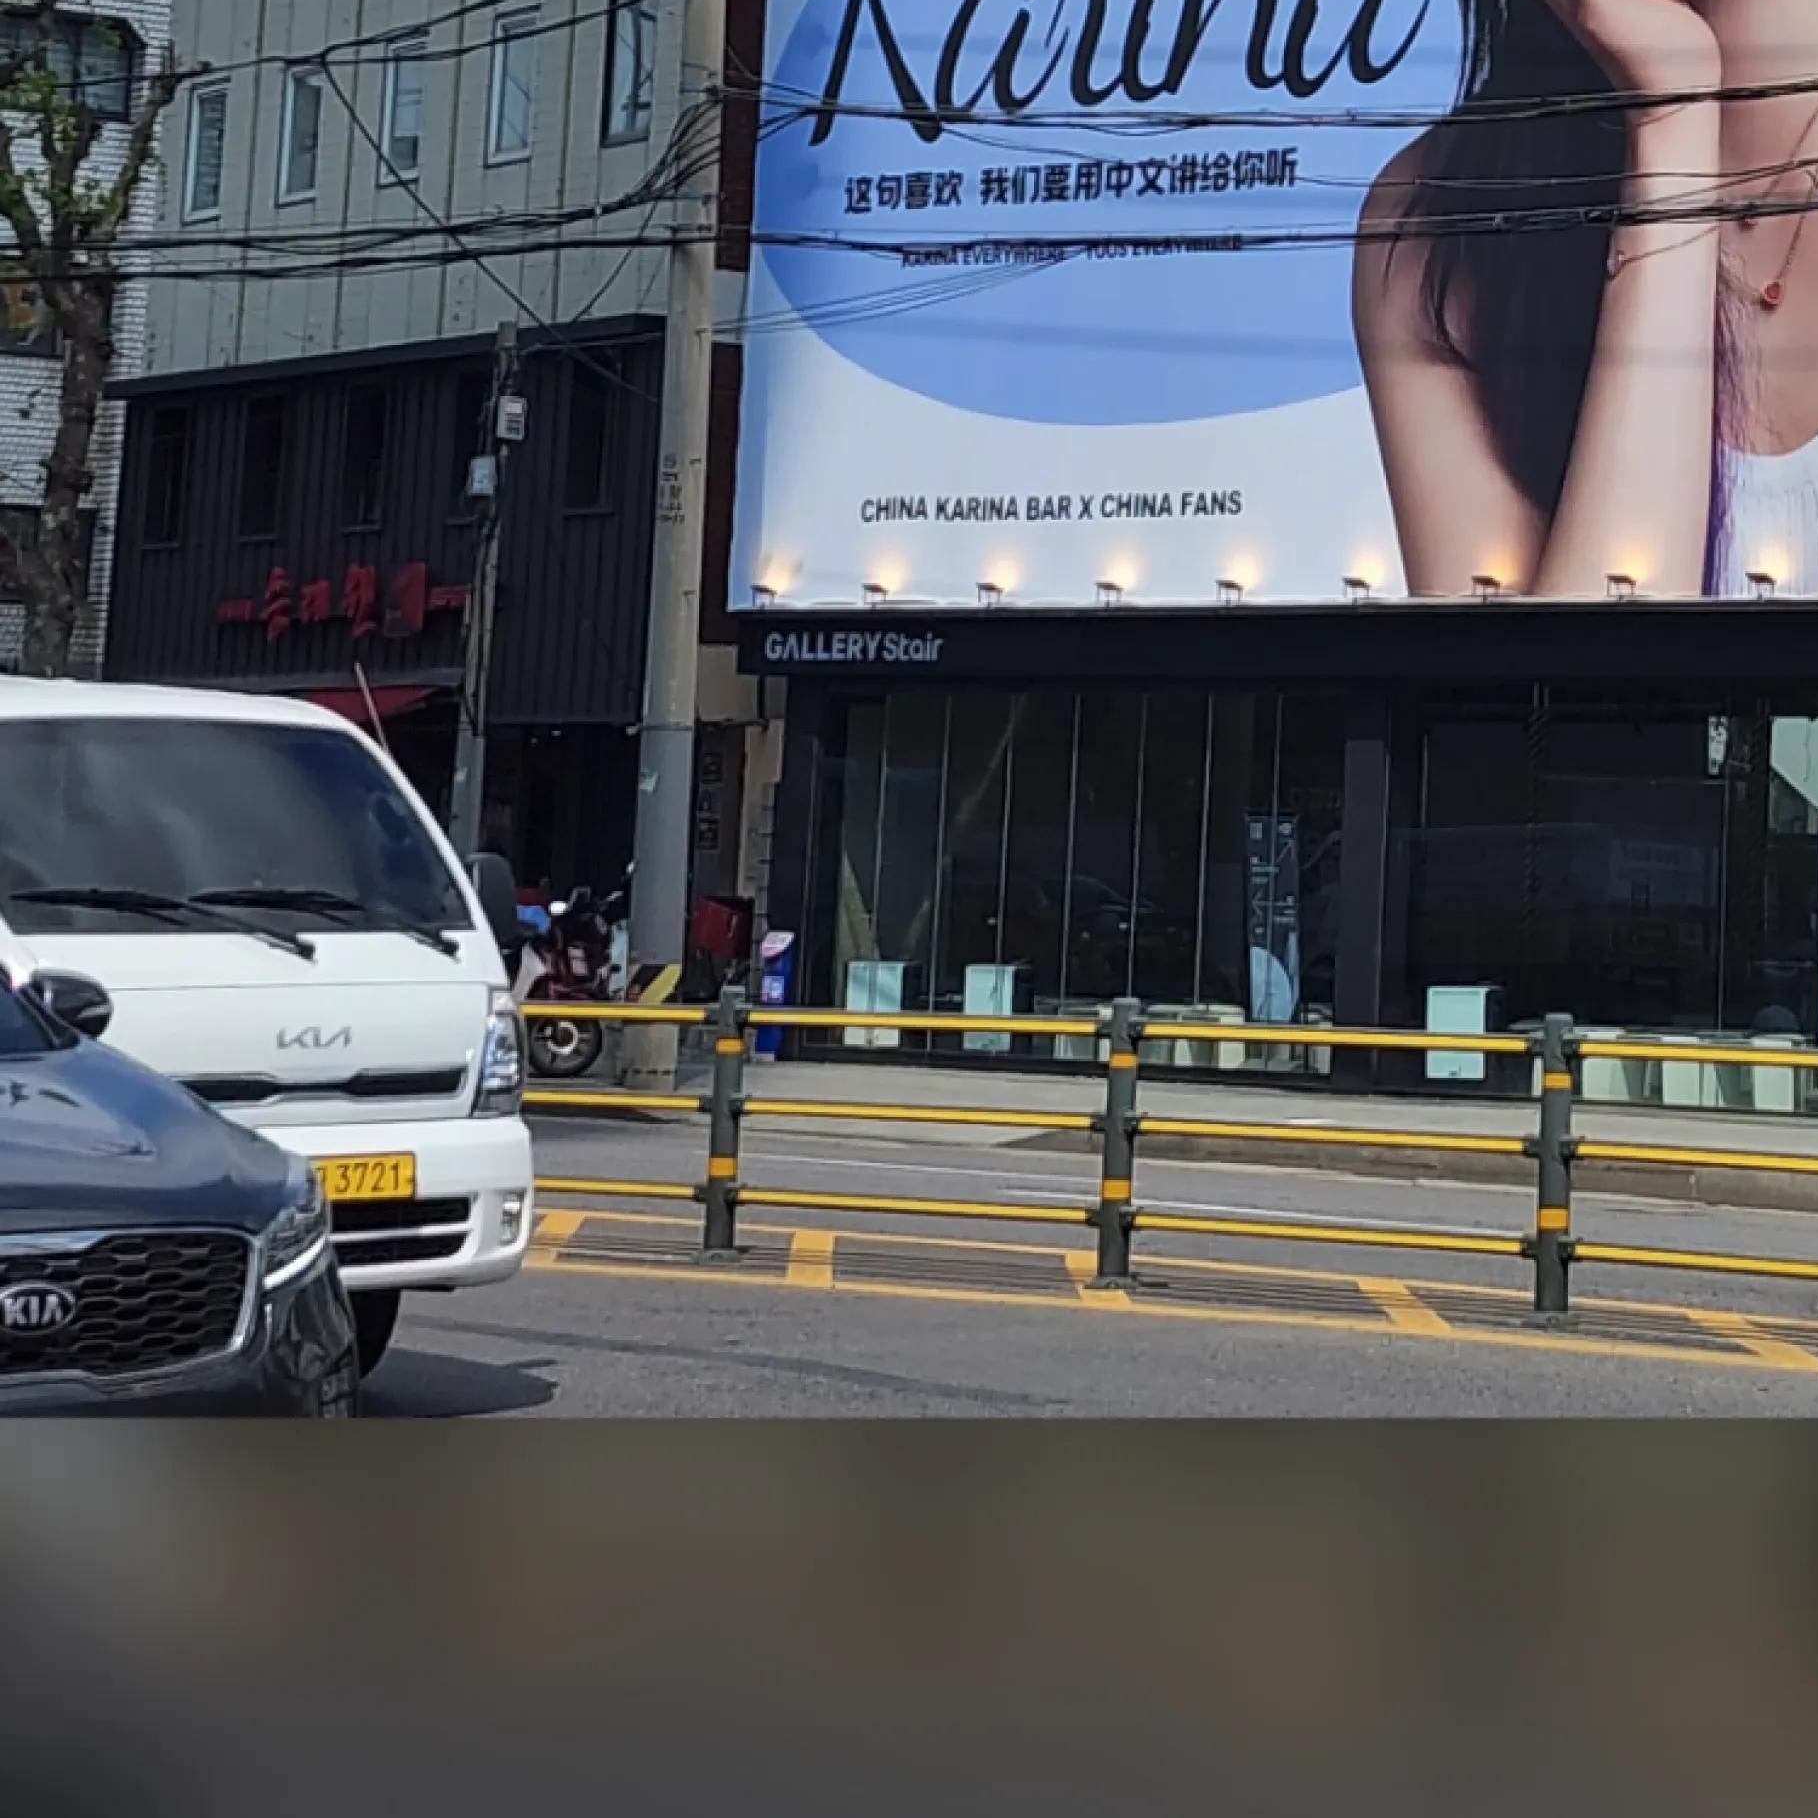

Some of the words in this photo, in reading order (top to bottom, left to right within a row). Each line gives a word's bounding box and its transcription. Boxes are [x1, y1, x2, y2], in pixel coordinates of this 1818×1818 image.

[844, 171, 963, 215] 这句喜欢
[979, 147, 1298, 207] 我们要用中文讲给你听
[861, 496, 928, 523] CHINA
[935, 495, 1019, 522] KARINA
[1026, 494, 1071, 521] BAR
[1077, 494, 1094, 520] X
[1101, 492, 1173, 519] CHINA
[1180, 490, 1243, 516] FANS
[276, 1026, 352, 1050] KIA
[335, 1160, 400, 1193] 3721
[4, 1293, 63, 1326] KIA
